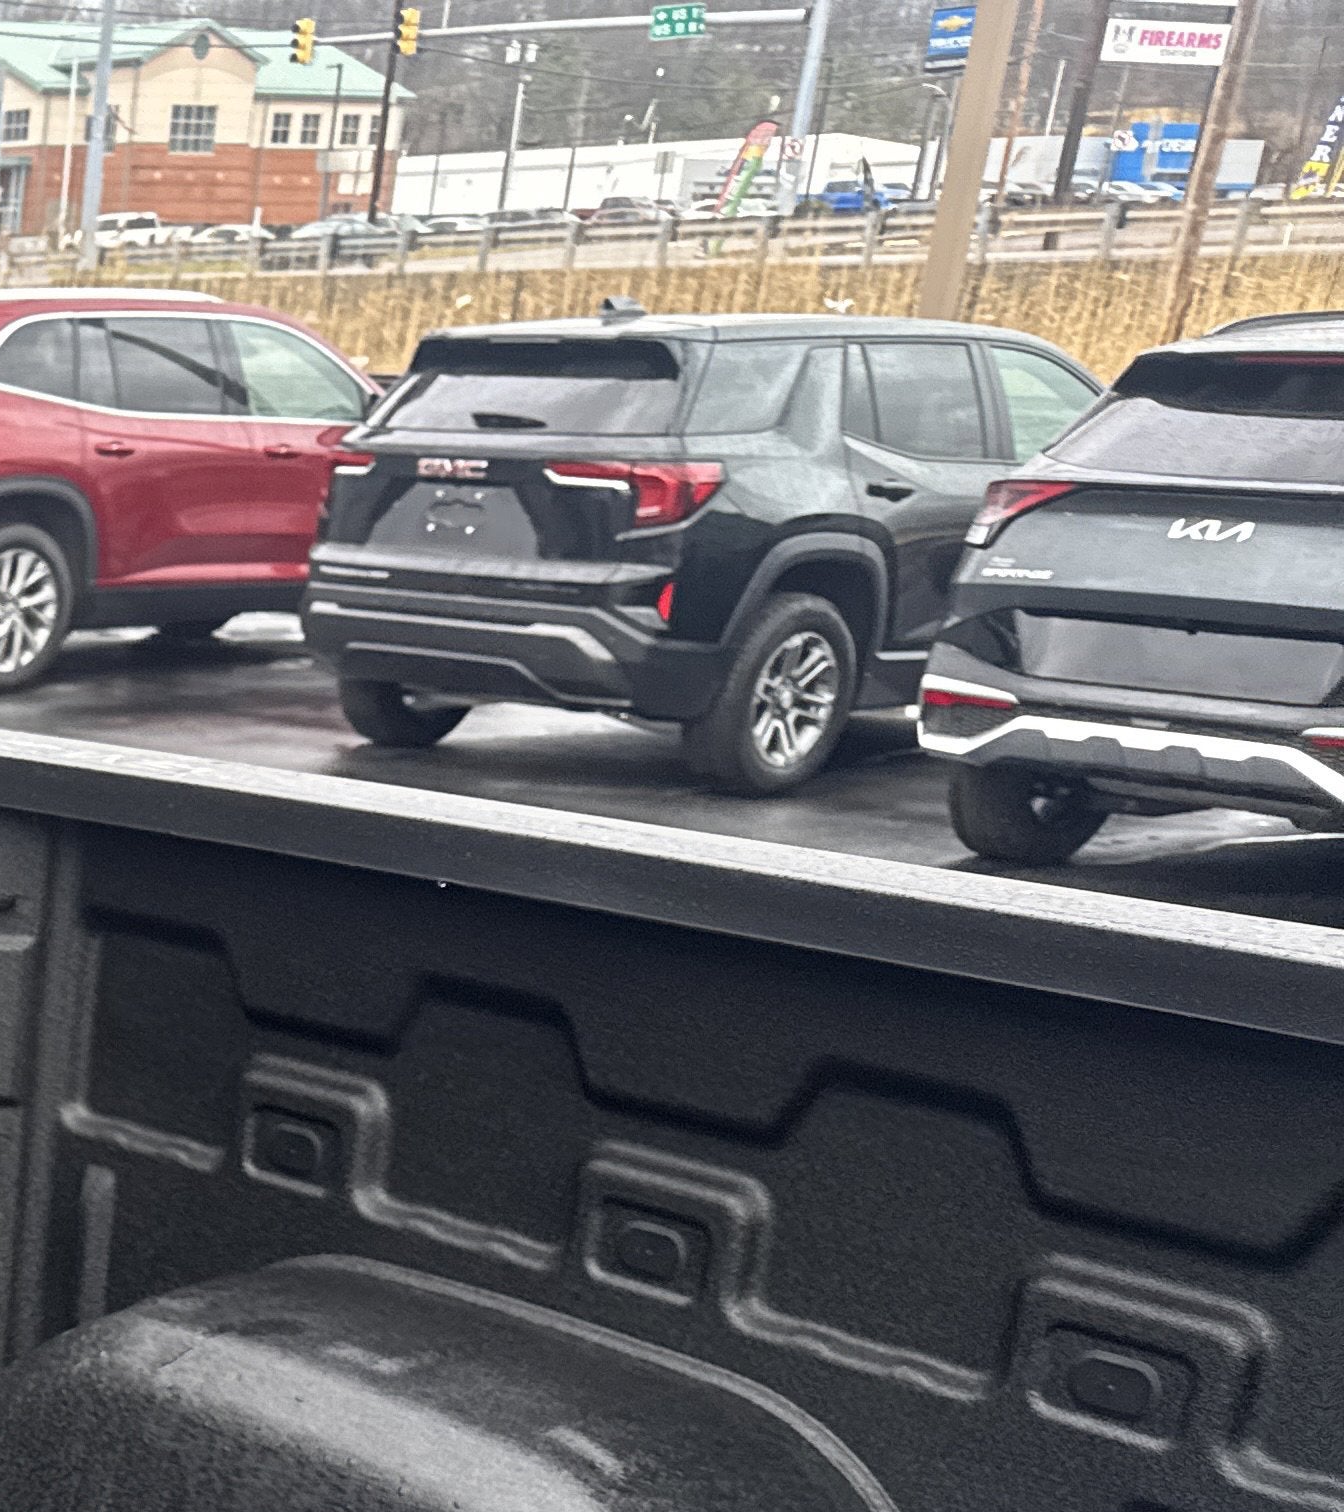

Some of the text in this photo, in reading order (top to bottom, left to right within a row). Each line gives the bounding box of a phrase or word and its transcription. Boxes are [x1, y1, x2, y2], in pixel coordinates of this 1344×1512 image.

[1138, 29, 1223, 50] FIREARMS
[417, 457, 489, 478] GMC
[1167, 518, 1256, 542] KIA
